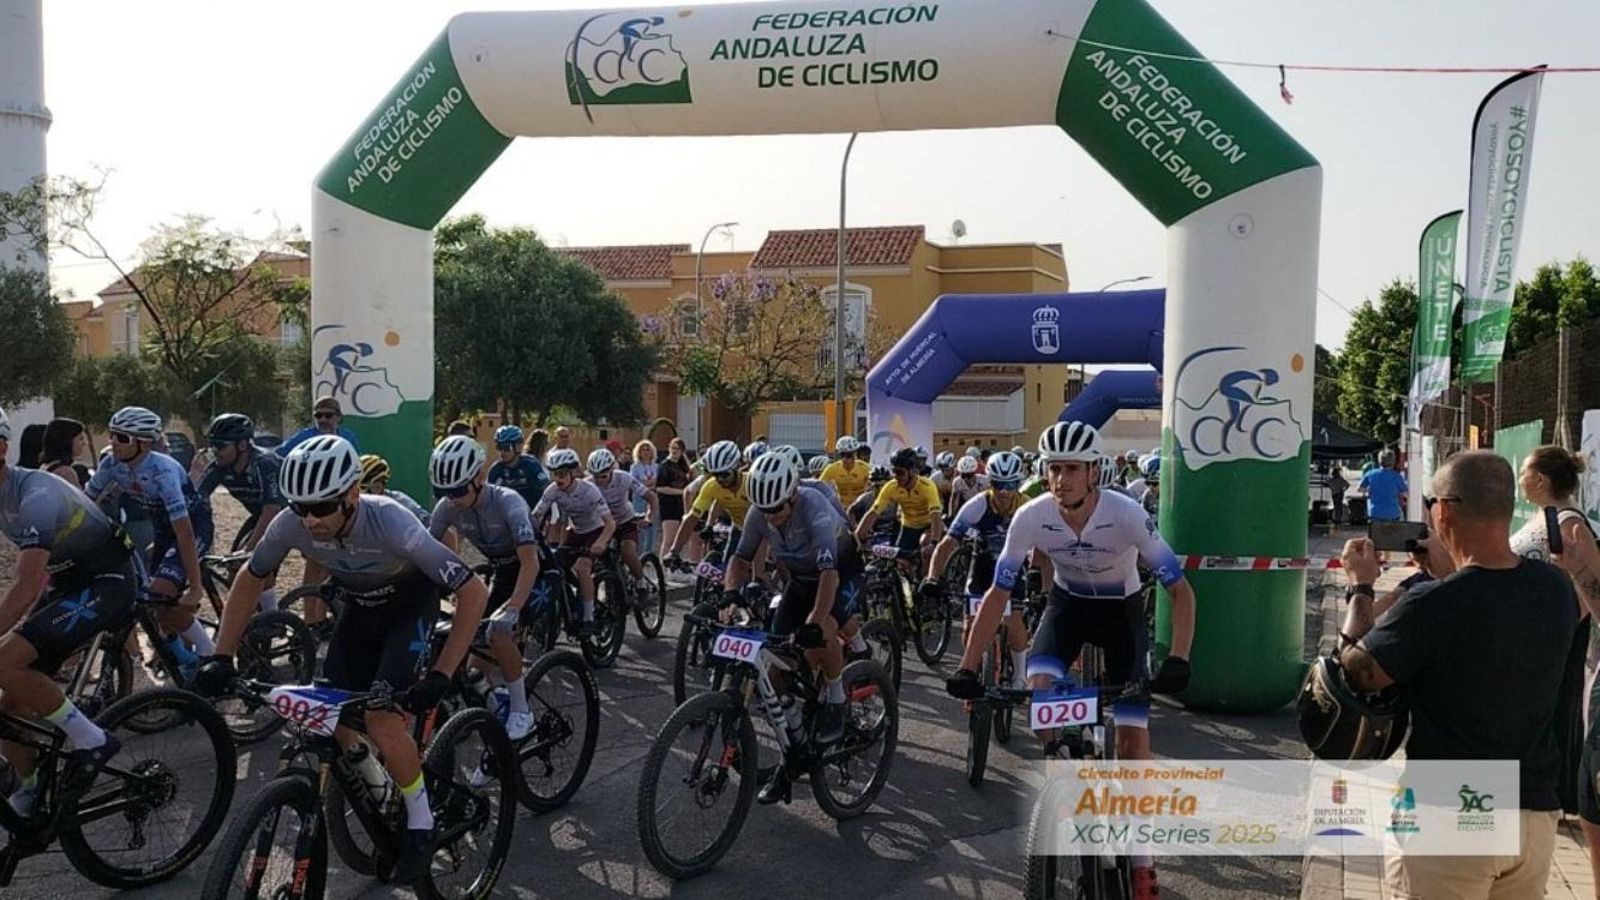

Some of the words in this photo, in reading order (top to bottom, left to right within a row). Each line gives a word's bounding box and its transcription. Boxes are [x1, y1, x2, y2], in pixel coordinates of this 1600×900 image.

[710, 33, 866, 60] ANDALUZA
[758, 66, 795, 88] DE
[802, 59, 939, 87] CICLISMO
[377, 156, 402, 183] DE
[398, 87, 462, 160] CICLISMO
[1086, 50, 1187, 145] ANDALUZA
[1126, 54, 1247, 164] FEDERACIÓN
[347, 109, 420, 193] ANDALUZA
[1099, 91, 1130, 122] DE
[1126, 118, 1213, 199] CICLISMO
[1494, 105, 1526, 293] #YOSOYCICLISTA
[718, 637, 753, 658] 040
[275, 694, 328, 731] 002
[1037, 702, 1088, 725] 020
